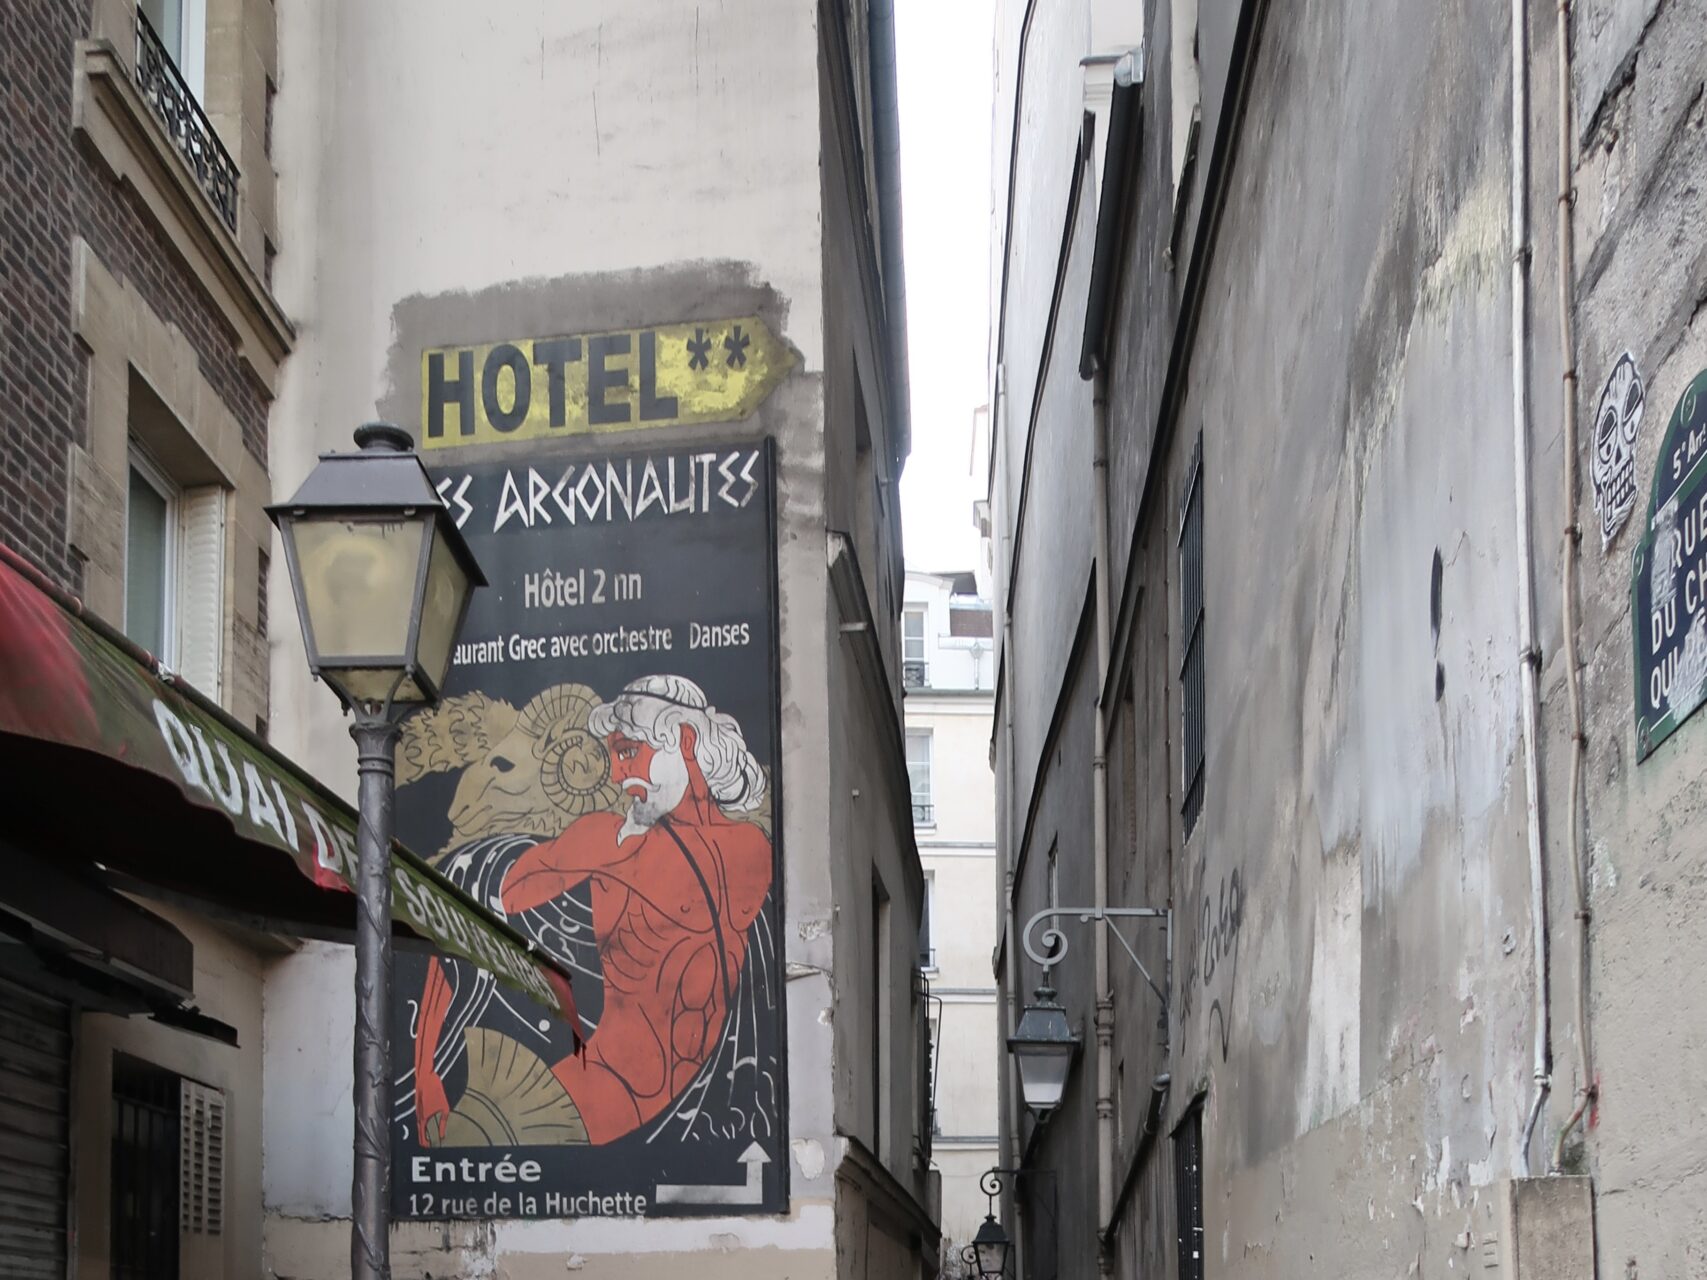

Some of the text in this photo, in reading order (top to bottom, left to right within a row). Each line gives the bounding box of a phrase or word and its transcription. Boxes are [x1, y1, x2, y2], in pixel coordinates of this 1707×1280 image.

[428, 331, 678, 438] HOTEL
[493, 450, 760, 534] ARGONAUTES
[524, 567, 642, 609] Hôtel 2 nn
[508, 633, 547, 661] Grec
[550, 635, 588, 658] avec
[592, 625, 673, 656] orchestre
[690, 622, 750, 649] Danses
[1651, 597, 1676, 656] DU
[152, 699, 299, 853] QUAI
[411, 1154, 542, 1184] Entrée
[409, 1190, 647, 1217] 12 rue de la Huchette
